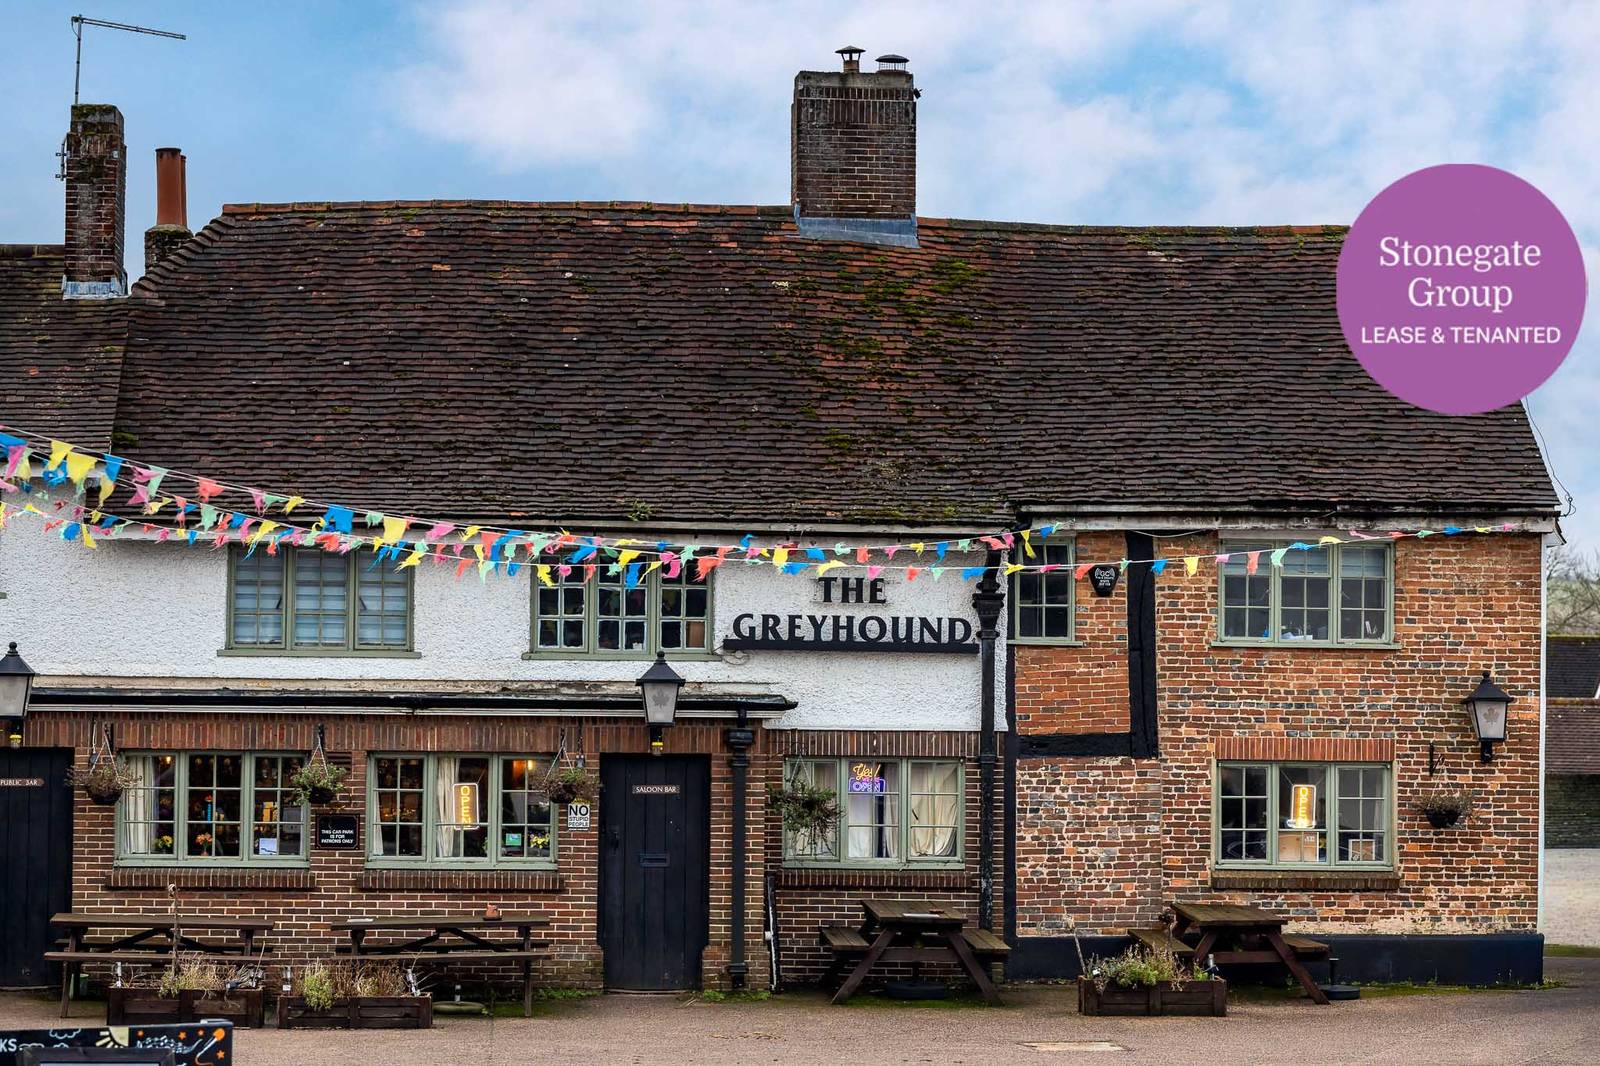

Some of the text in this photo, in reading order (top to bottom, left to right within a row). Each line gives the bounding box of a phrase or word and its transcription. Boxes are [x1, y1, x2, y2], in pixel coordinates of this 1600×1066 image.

[817, 576, 887, 604] THE
[732, 613, 973, 645] GREYHOUND
[852, 782, 881, 792] OPEN
[460, 785, 471, 827] OPEN
[569, 805, 589, 816] NO
